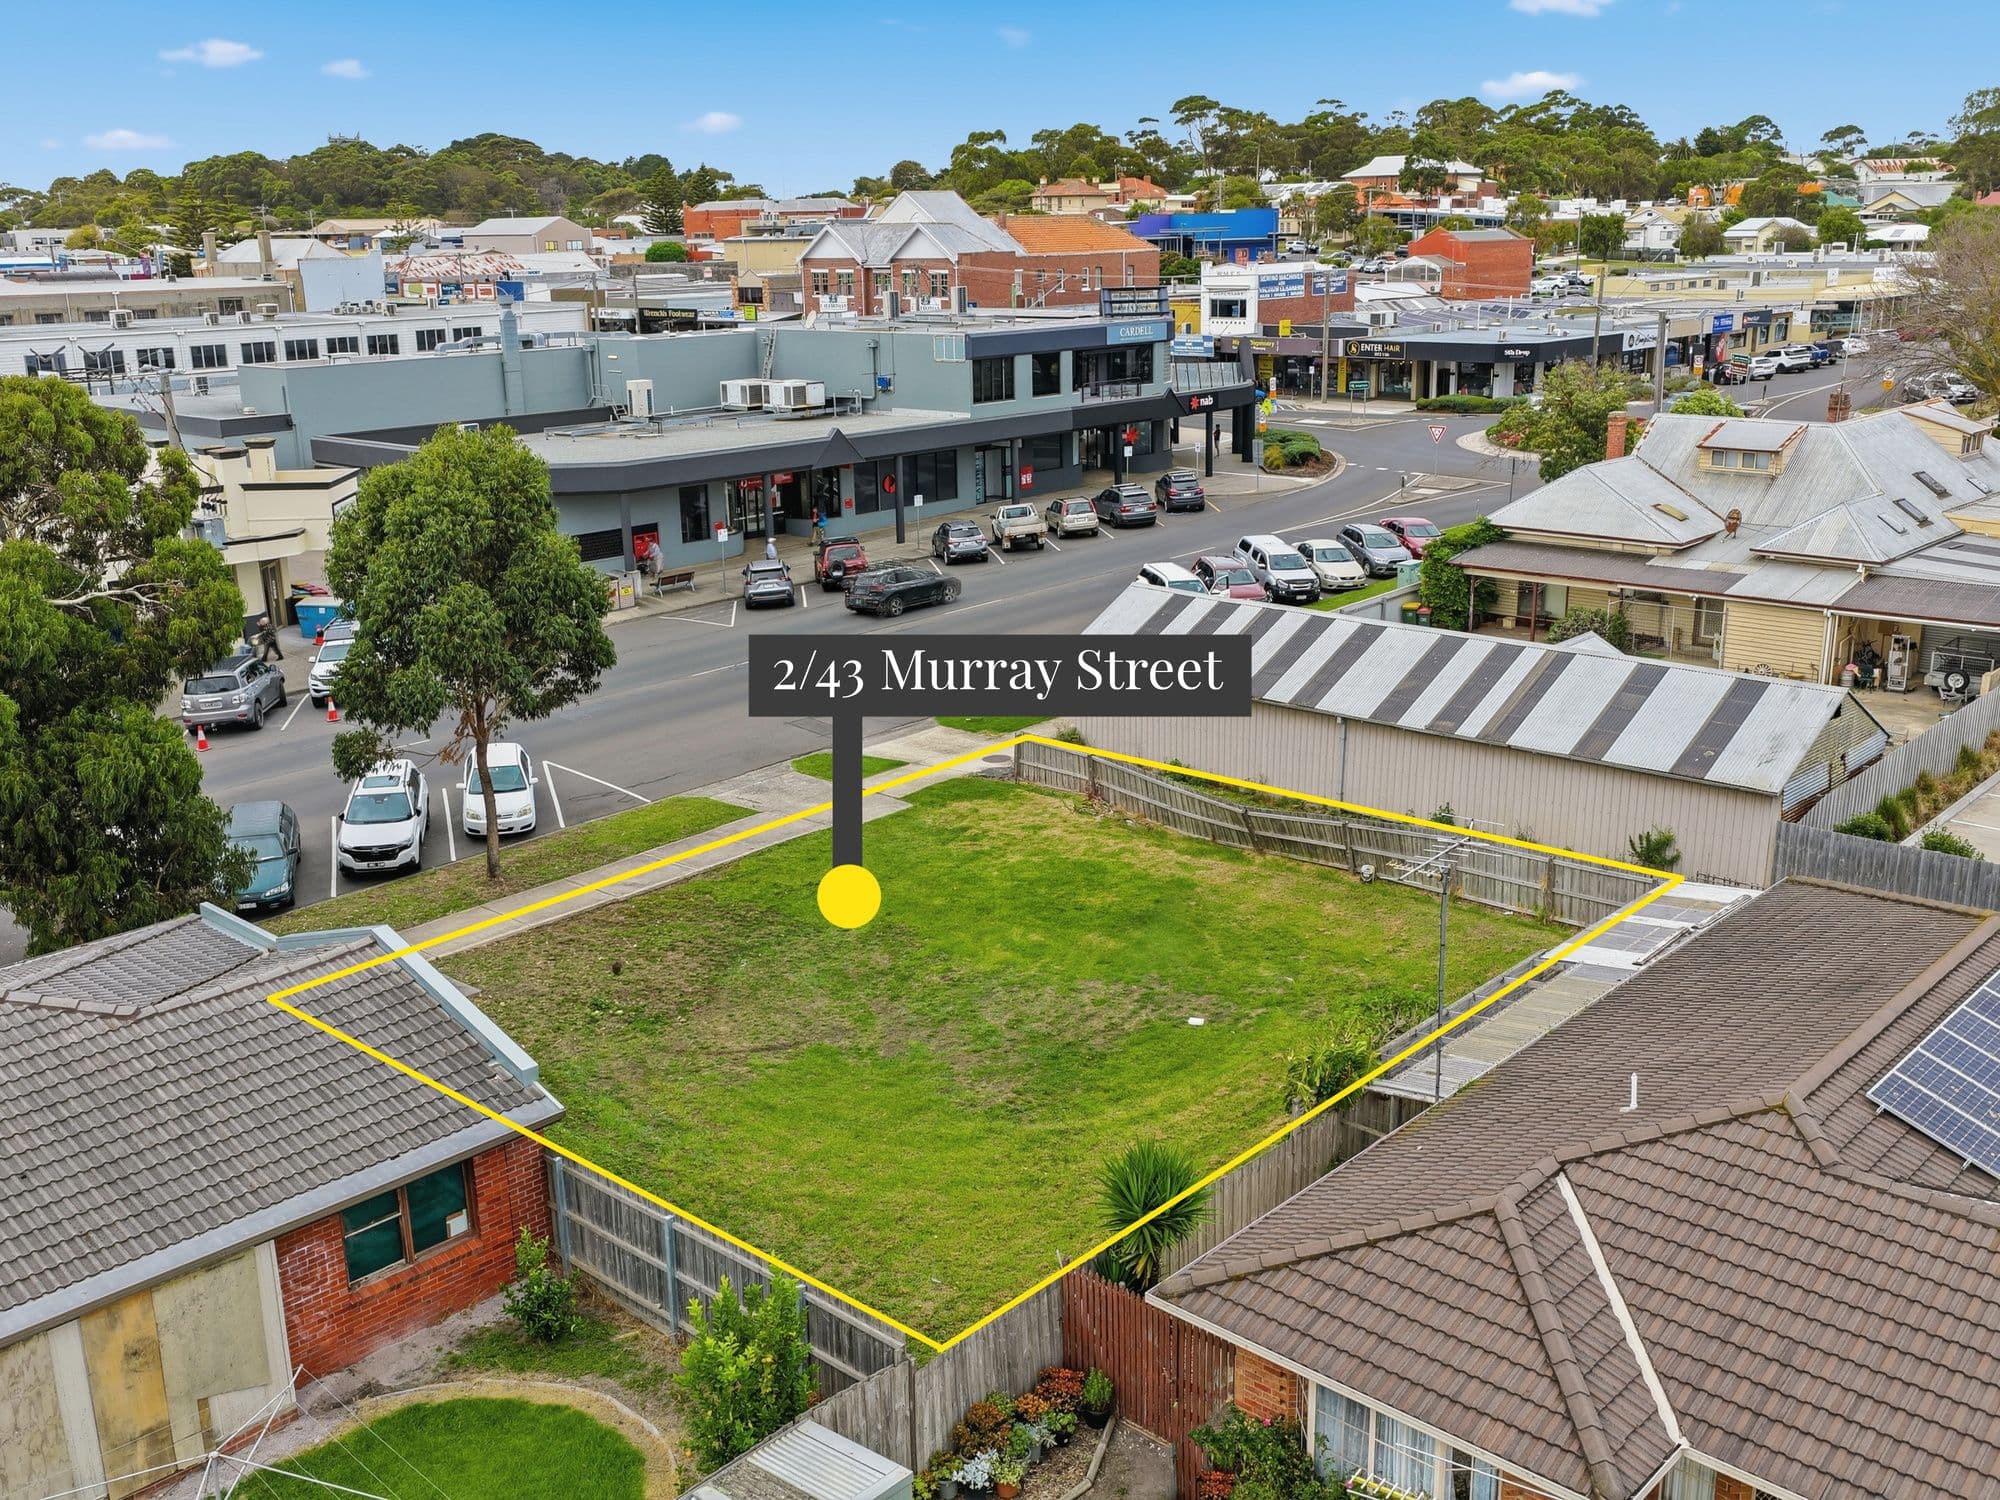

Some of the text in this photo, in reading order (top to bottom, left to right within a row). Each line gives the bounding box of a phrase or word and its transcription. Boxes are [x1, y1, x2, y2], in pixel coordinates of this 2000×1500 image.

[1120, 325, 1154, 337] CARDELL
[1361, 343, 1401, 353] ENTER HAIR
[1200, 394, 1214, 406] nab
